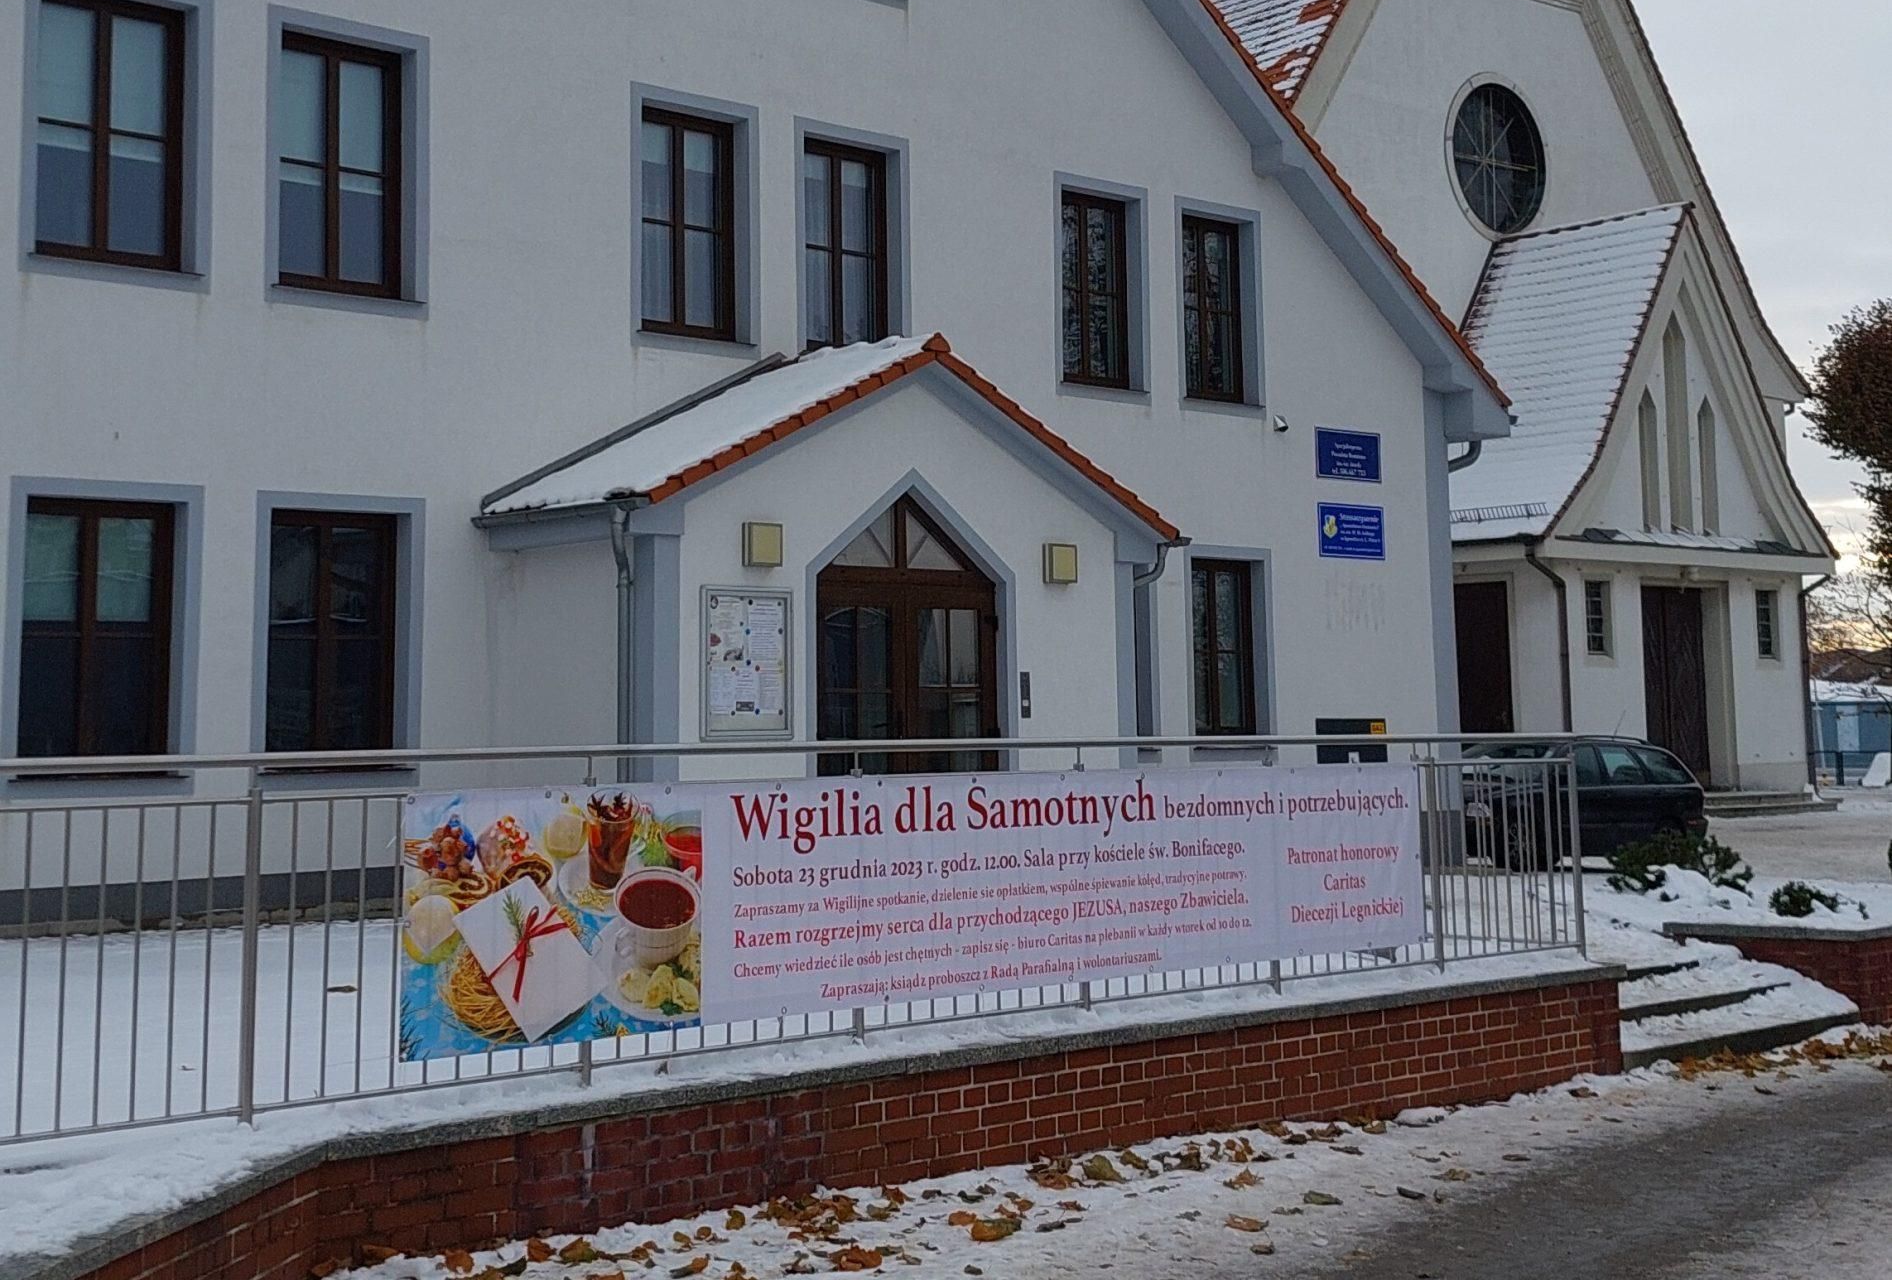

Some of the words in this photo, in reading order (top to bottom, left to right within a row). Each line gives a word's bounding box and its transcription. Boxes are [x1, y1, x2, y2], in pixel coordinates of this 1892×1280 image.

[729, 788, 884, 854] Wigilia
[894, 785, 957, 834] dla
[966, 778, 1156, 838] Samotnych
[1163, 791, 1275, 822] bezdomnych
[1278, 792, 1285, 814] i
[1287, 787, 1409, 820] potrzebujących.
[733, 864, 794, 888] Sobota
[798, 867, 815, 887] 23
[819, 858, 887, 888] grudnia
[890, 860, 923, 880] 2023
[926, 860, 938, 874] r.
[940, 852, 981, 879] godz.
[984, 854, 1021, 871] 12.00.
[1023, 847, 1055, 868] Sala
[1058, 850, 1091, 872] przy
[1093, 841, 1145, 864] kościele
[1148, 841, 1169, 860] św.
[1171, 837, 1246, 861] Bonifacego.
[1287, 847, 1339, 865] Patronat
[1339, 843, 1399, 863] honorowy
[733, 901, 805, 921] Zapraszamy
[822, 894, 874, 914] Wigilijne
[876, 891, 930, 911] spotkanie,
[931, 886, 978, 903] dzielenie
[1049, 878, 1091, 897] wspólne
[1091, 875, 1136, 895] śpiewanie
[1165, 869, 1212, 888] tradycyjne
[1323, 872, 1367, 892] Caritas
[734, 928, 792, 950] Razem
[795, 920, 884, 948] rozgrzejmy
[886, 918, 925, 937] serca
[928, 911, 954, 933] dla
[956, 904, 1070, 936] przychodzącego
[1071, 897, 1127, 924] JEZUSA,
[1128, 897, 1179, 916] naszego
[1179, 887, 1250, 910] Zbawiciela.
[1290, 900, 1339, 924] Diecezji
[1341, 896, 1405, 923] Legnickiej
[733, 962, 782, 979] Chcemy
[784, 954, 838, 974] wiedzieć
[839, 952, 854, 969] ile
[856, 949, 882, 967] osób
[883, 949, 904, 968] jest
[905, 943, 953, 963] chętnych
[961, 939, 994, 960] zapisz
[994, 938, 1010, 955] się
[1017, 933, 1046, 950] biuro
[1047, 933, 1083, 947] Caritas
[1085, 935, 1097, 944] na
[1098, 925, 1138, 947] plebanii
[1138, 928, 1147, 937] w
[1147, 922, 1173, 938] każdy
[1174, 919, 1206, 934] wtorek
[1205, 917, 1218, 931] od
[1229, 916, 1242, 929] do
[820, 978, 888, 1001] Zapraszają:
[890, 972, 926, 993] ksiądz
[928, 969, 981, 991] proboszcz
[982, 970, 988, 980] z
[991, 963, 1020, 981] Radą
[1021, 958, 1075, 975] Parafialną
[1077, 956, 1082, 970] i
[1083, 948, 1163, 970] wolontariuszami.
